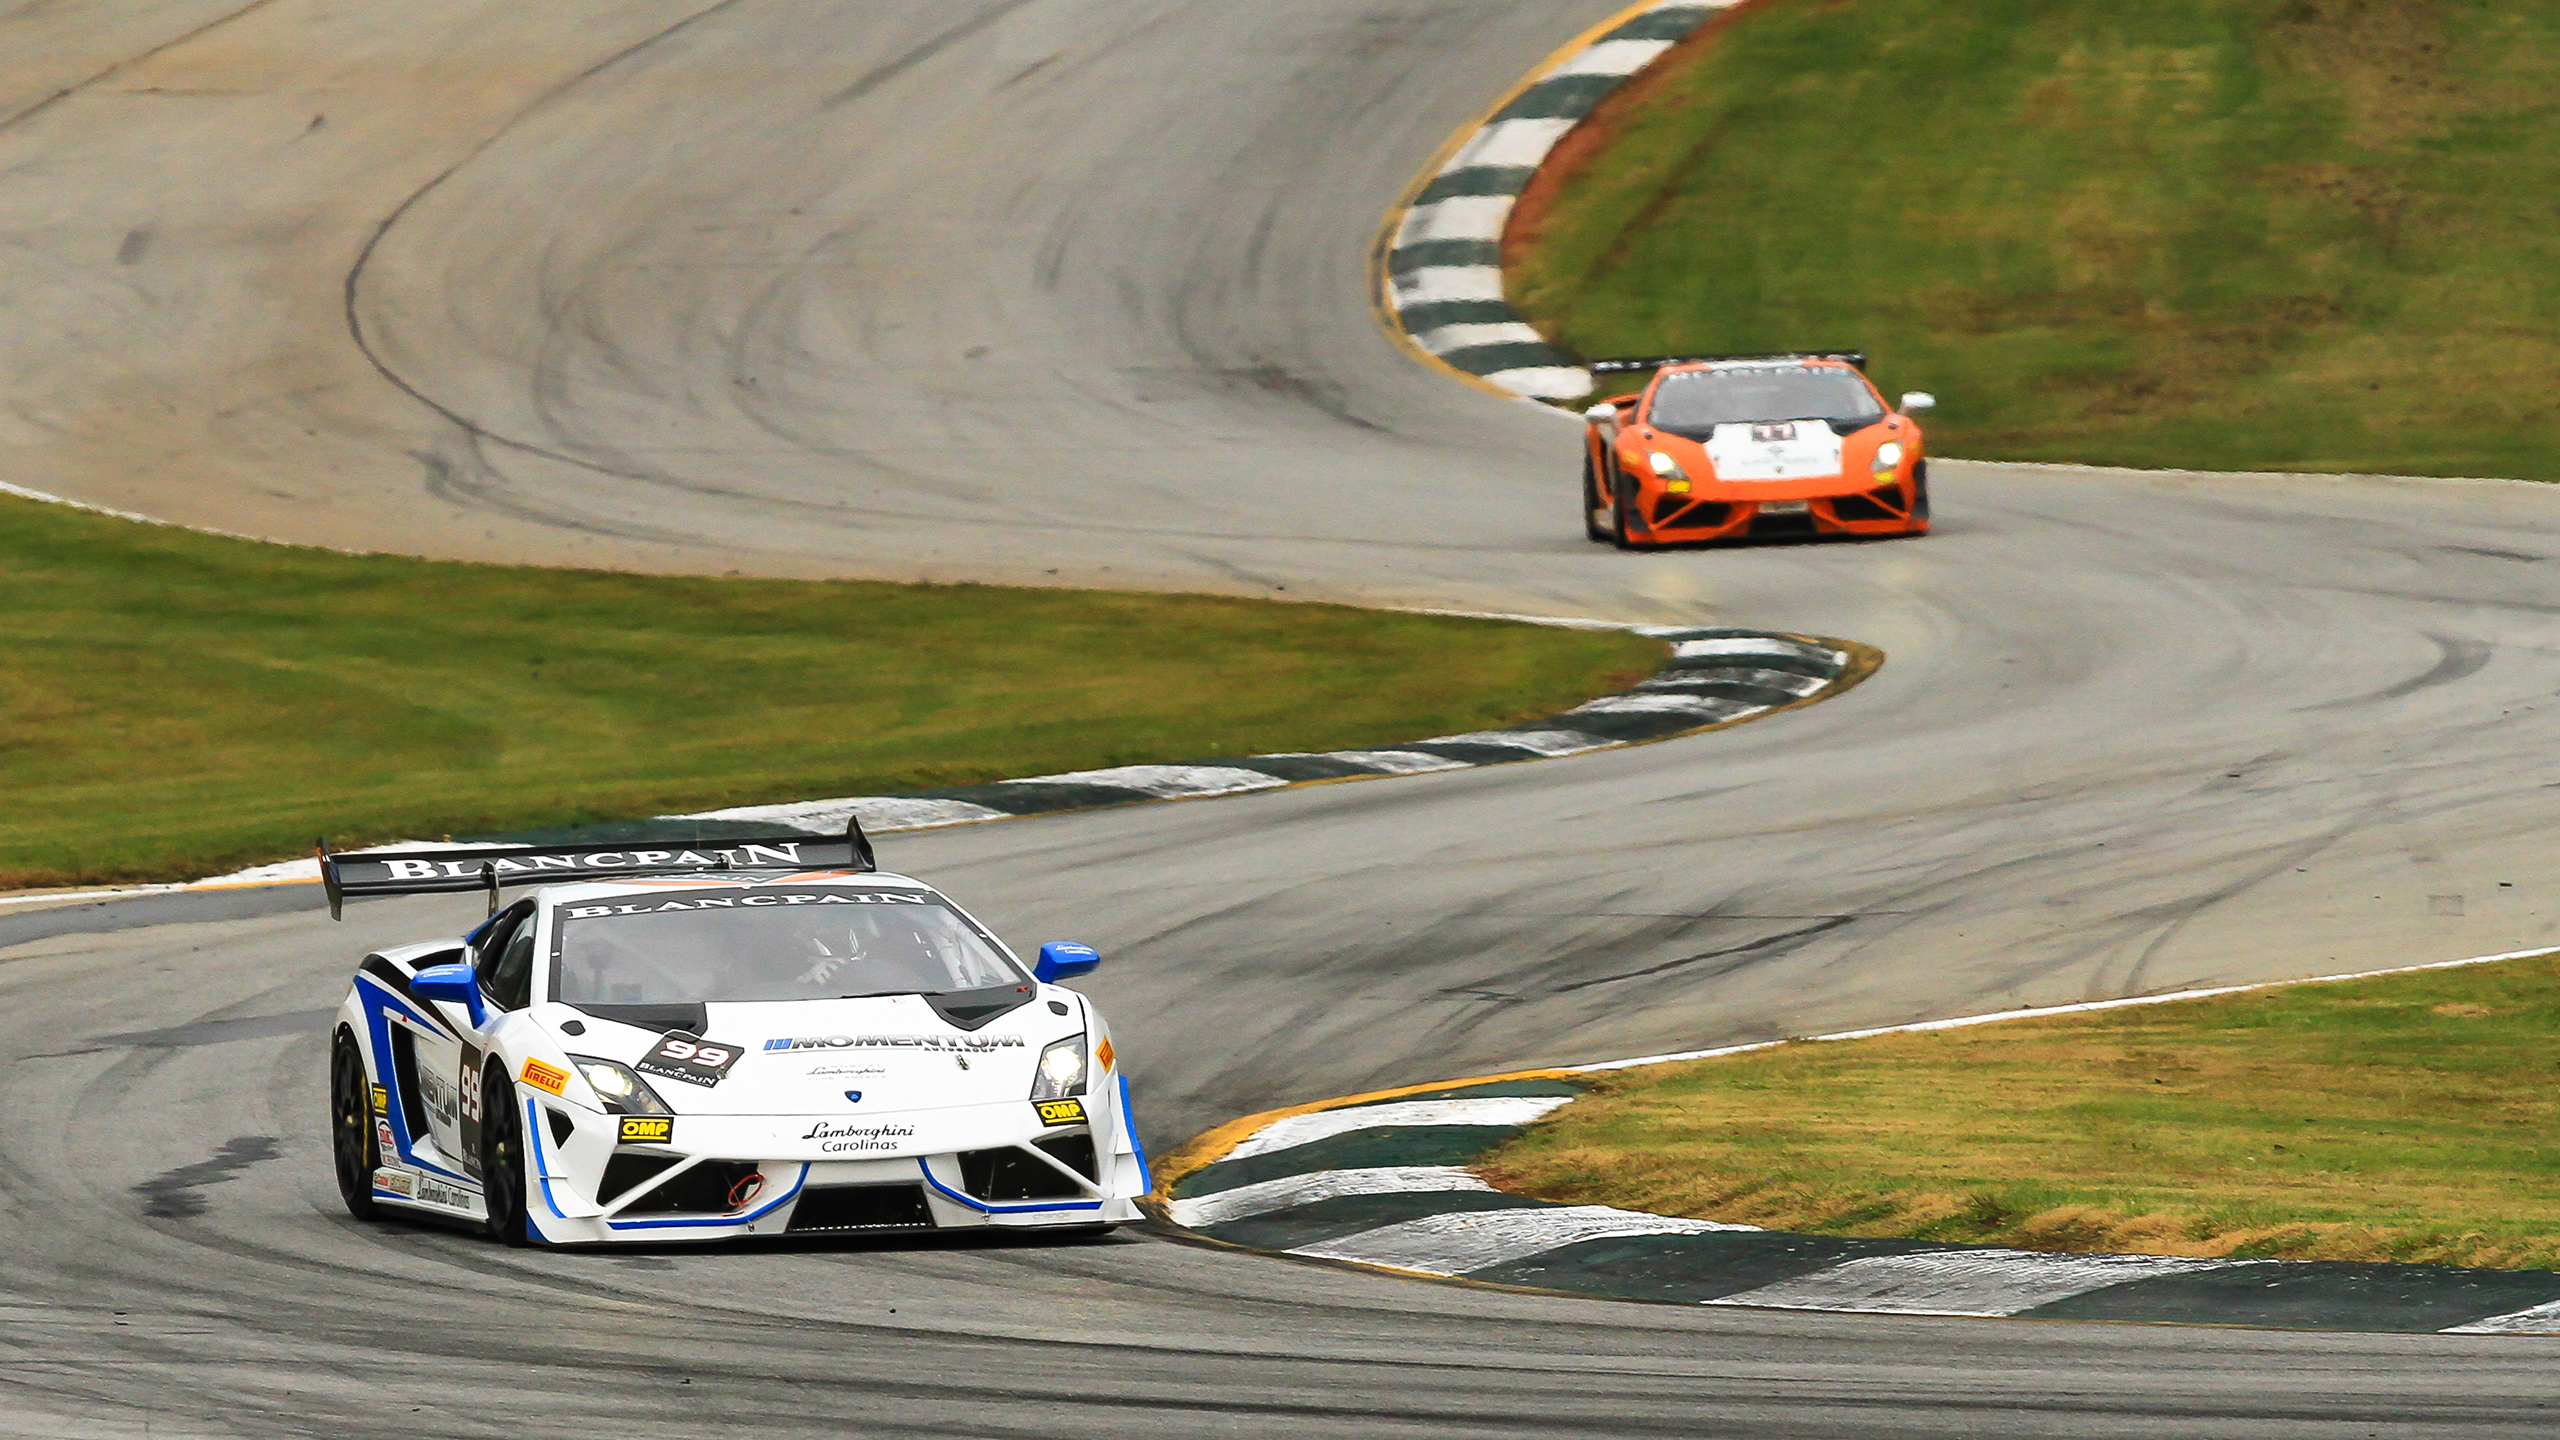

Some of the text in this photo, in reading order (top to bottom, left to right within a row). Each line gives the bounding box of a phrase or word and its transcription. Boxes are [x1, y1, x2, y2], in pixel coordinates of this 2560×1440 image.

[380, 842, 800, 881] BLANCPAIN
[565, 892, 926, 920] BLANCPAIN
[659, 1039, 731, 1069] 99
[792, 1034, 1026, 1050] MOMENTUM
[524, 1062, 565, 1091] PIRELLI
[638, 1062, 716, 1086] BLANCPAIN
[461, 1063, 480, 1123] 99
[1040, 1103, 1080, 1119] OMP
[622, 1121, 669, 1136] OMP
[802, 1122, 915, 1140] Lamborghini
[822, 1140, 898, 1152] Carolinas
